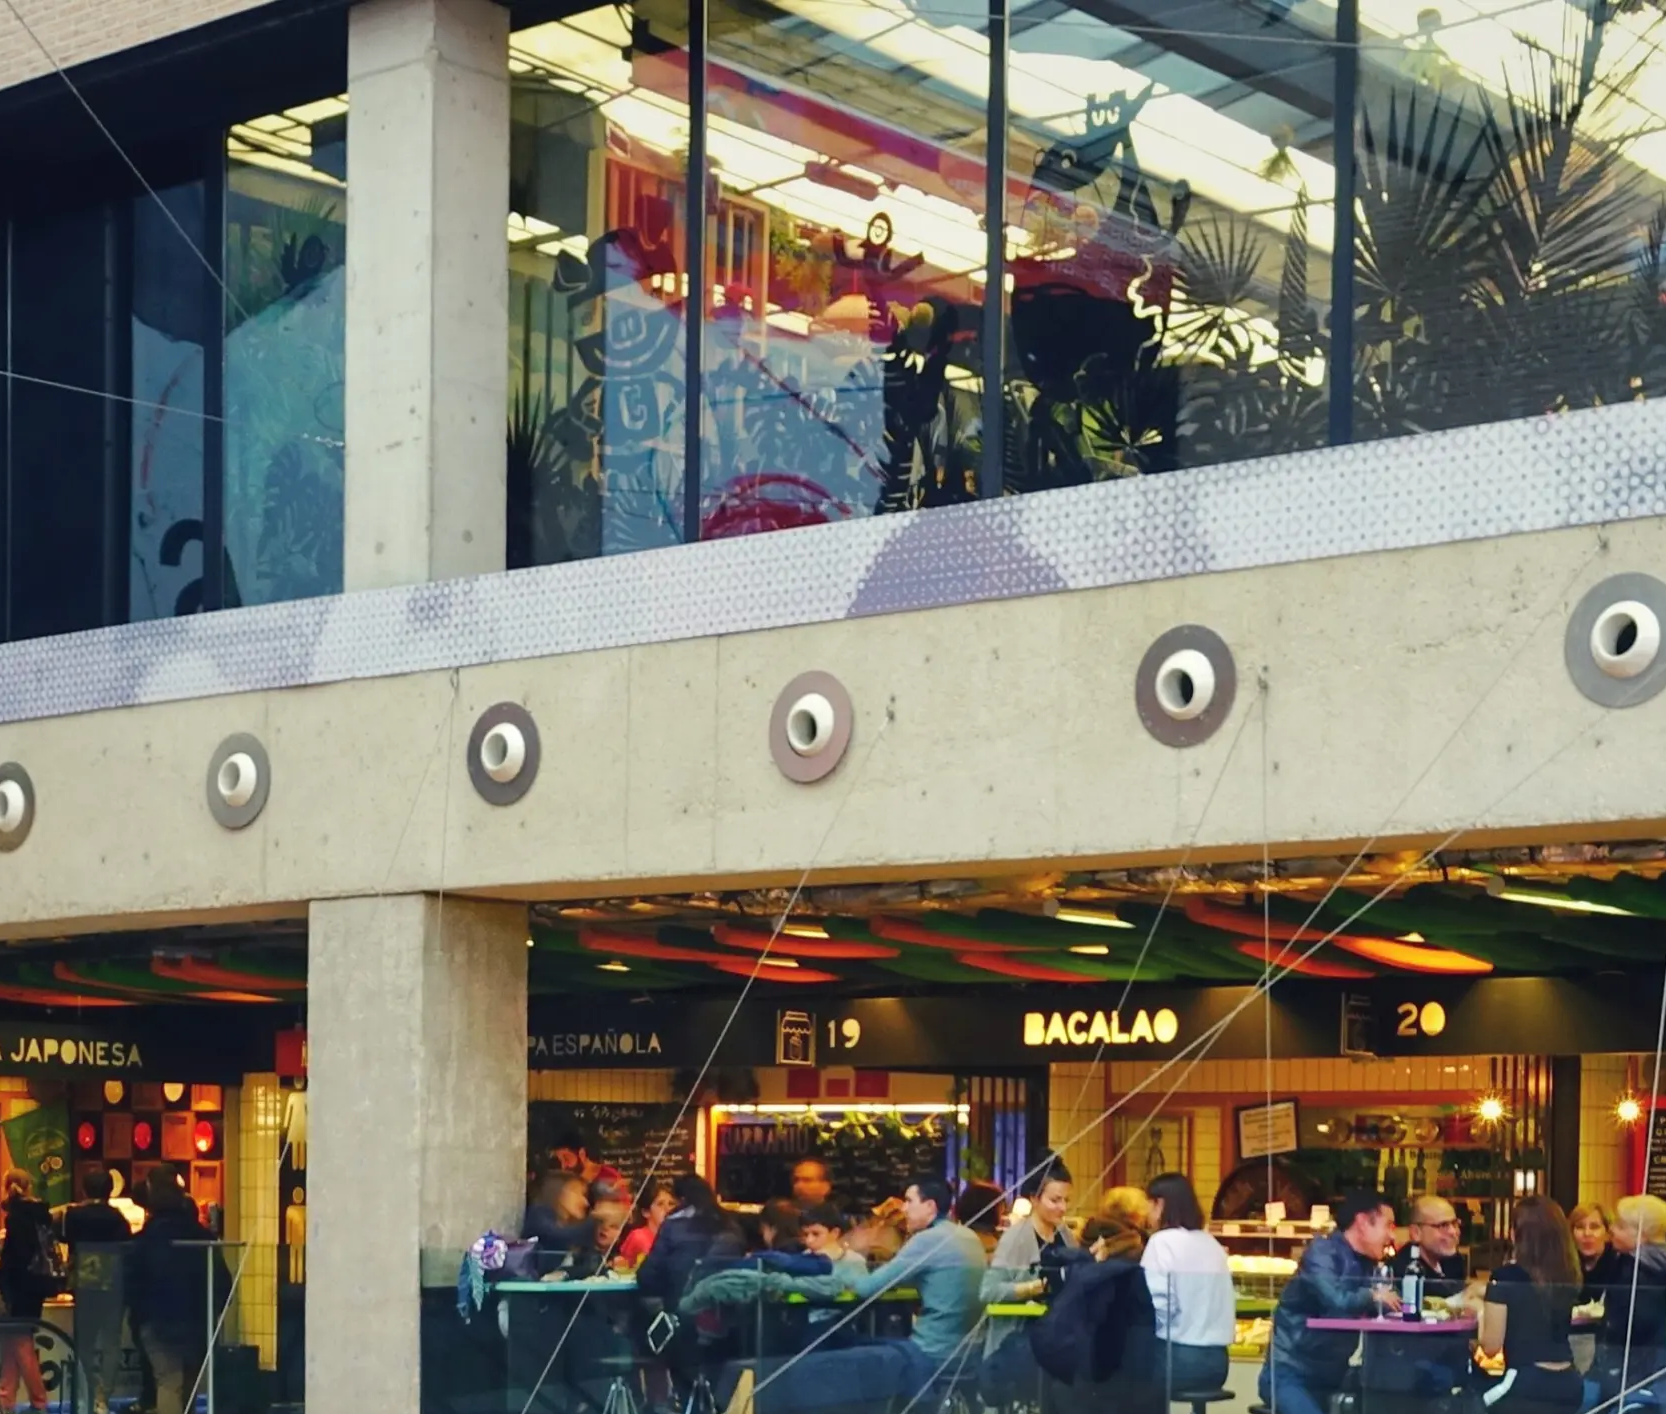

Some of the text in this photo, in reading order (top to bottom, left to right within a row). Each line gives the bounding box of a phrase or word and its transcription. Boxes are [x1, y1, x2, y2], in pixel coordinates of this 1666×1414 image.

[827, 1018, 861, 1048] 19
[1024, 1008, 1178, 1045] BACALAO
[1397, 1001, 1445, 1037] 20
[10, 1037, 143, 1067] JAPONESA
[553, 1028, 662, 1056] ESPAÑOLA
